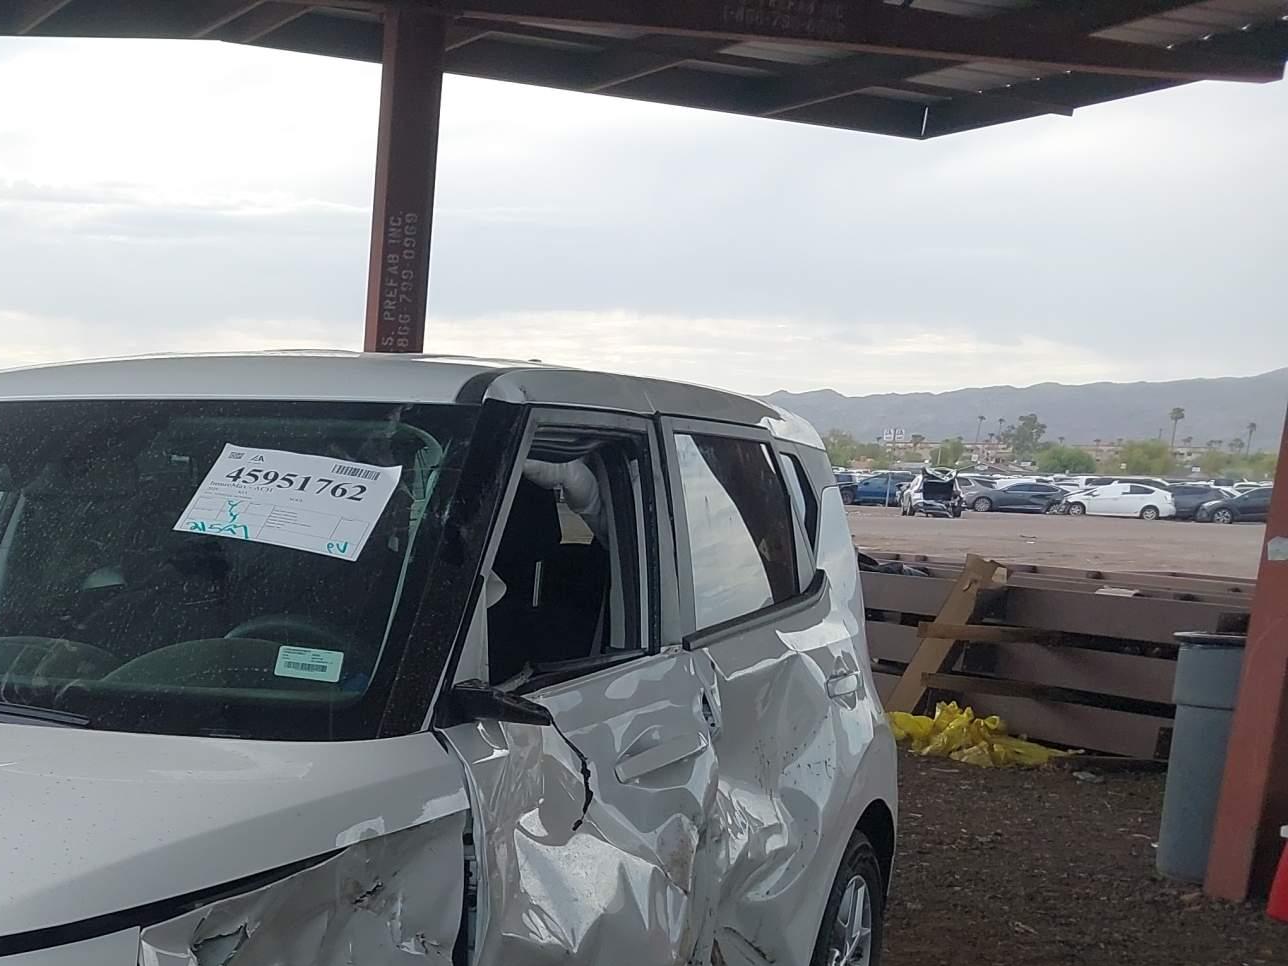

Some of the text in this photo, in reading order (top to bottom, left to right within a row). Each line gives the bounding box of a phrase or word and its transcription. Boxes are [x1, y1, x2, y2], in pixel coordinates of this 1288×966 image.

[387, 210, 404, 248] INC.
[383, 253, 400, 322] PREFAB
[225, 466, 368, 502] 45951762
